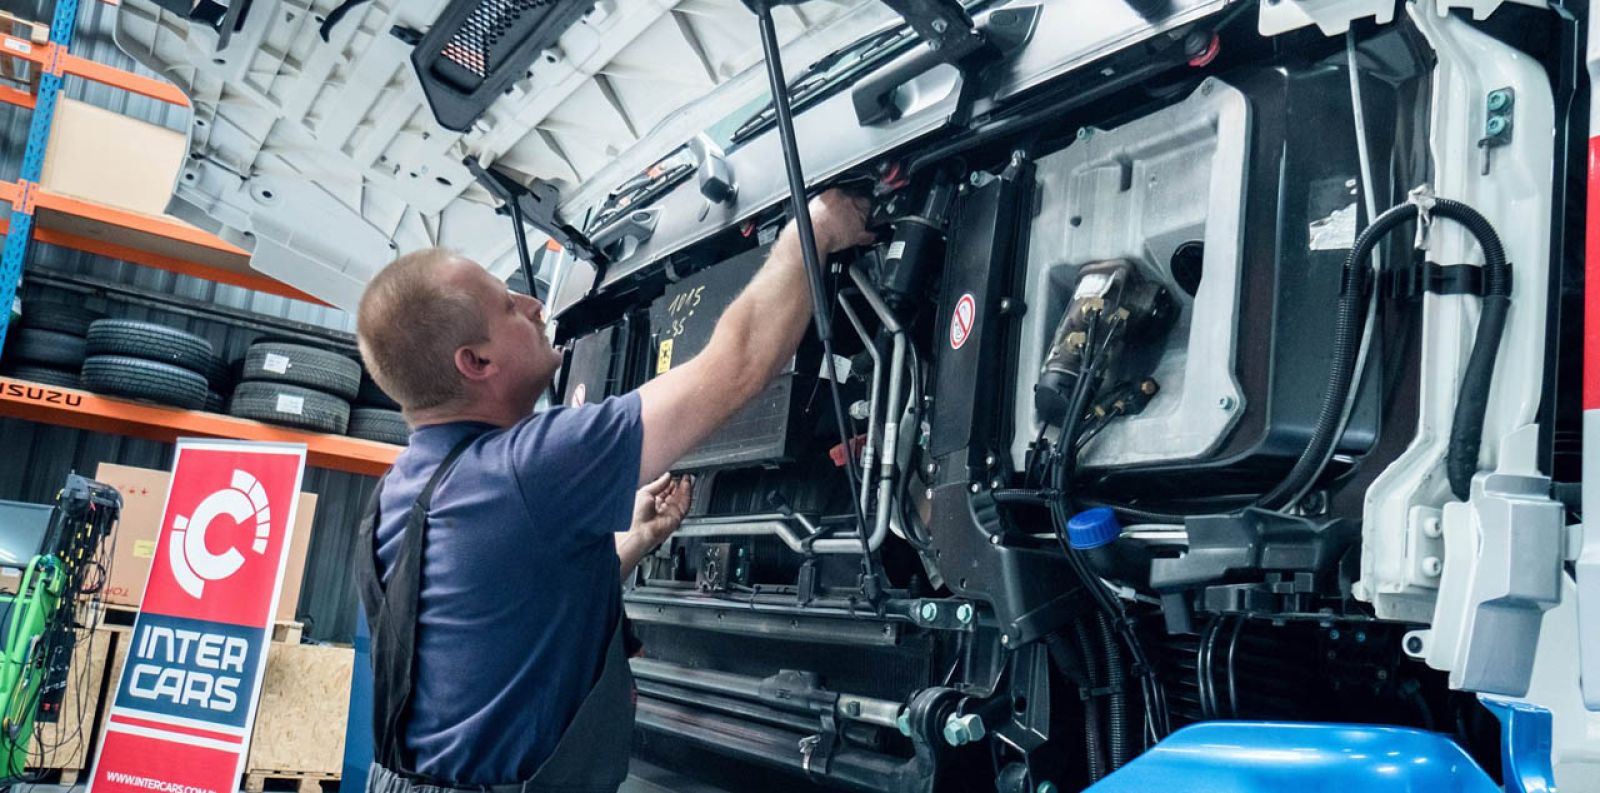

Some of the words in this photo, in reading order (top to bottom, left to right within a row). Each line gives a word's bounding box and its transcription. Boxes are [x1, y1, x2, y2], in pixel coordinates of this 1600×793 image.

[0, 382, 82, 407] ISUZU
[137, 625, 248, 673] INTER
[128, 664, 241, 712] CARS
